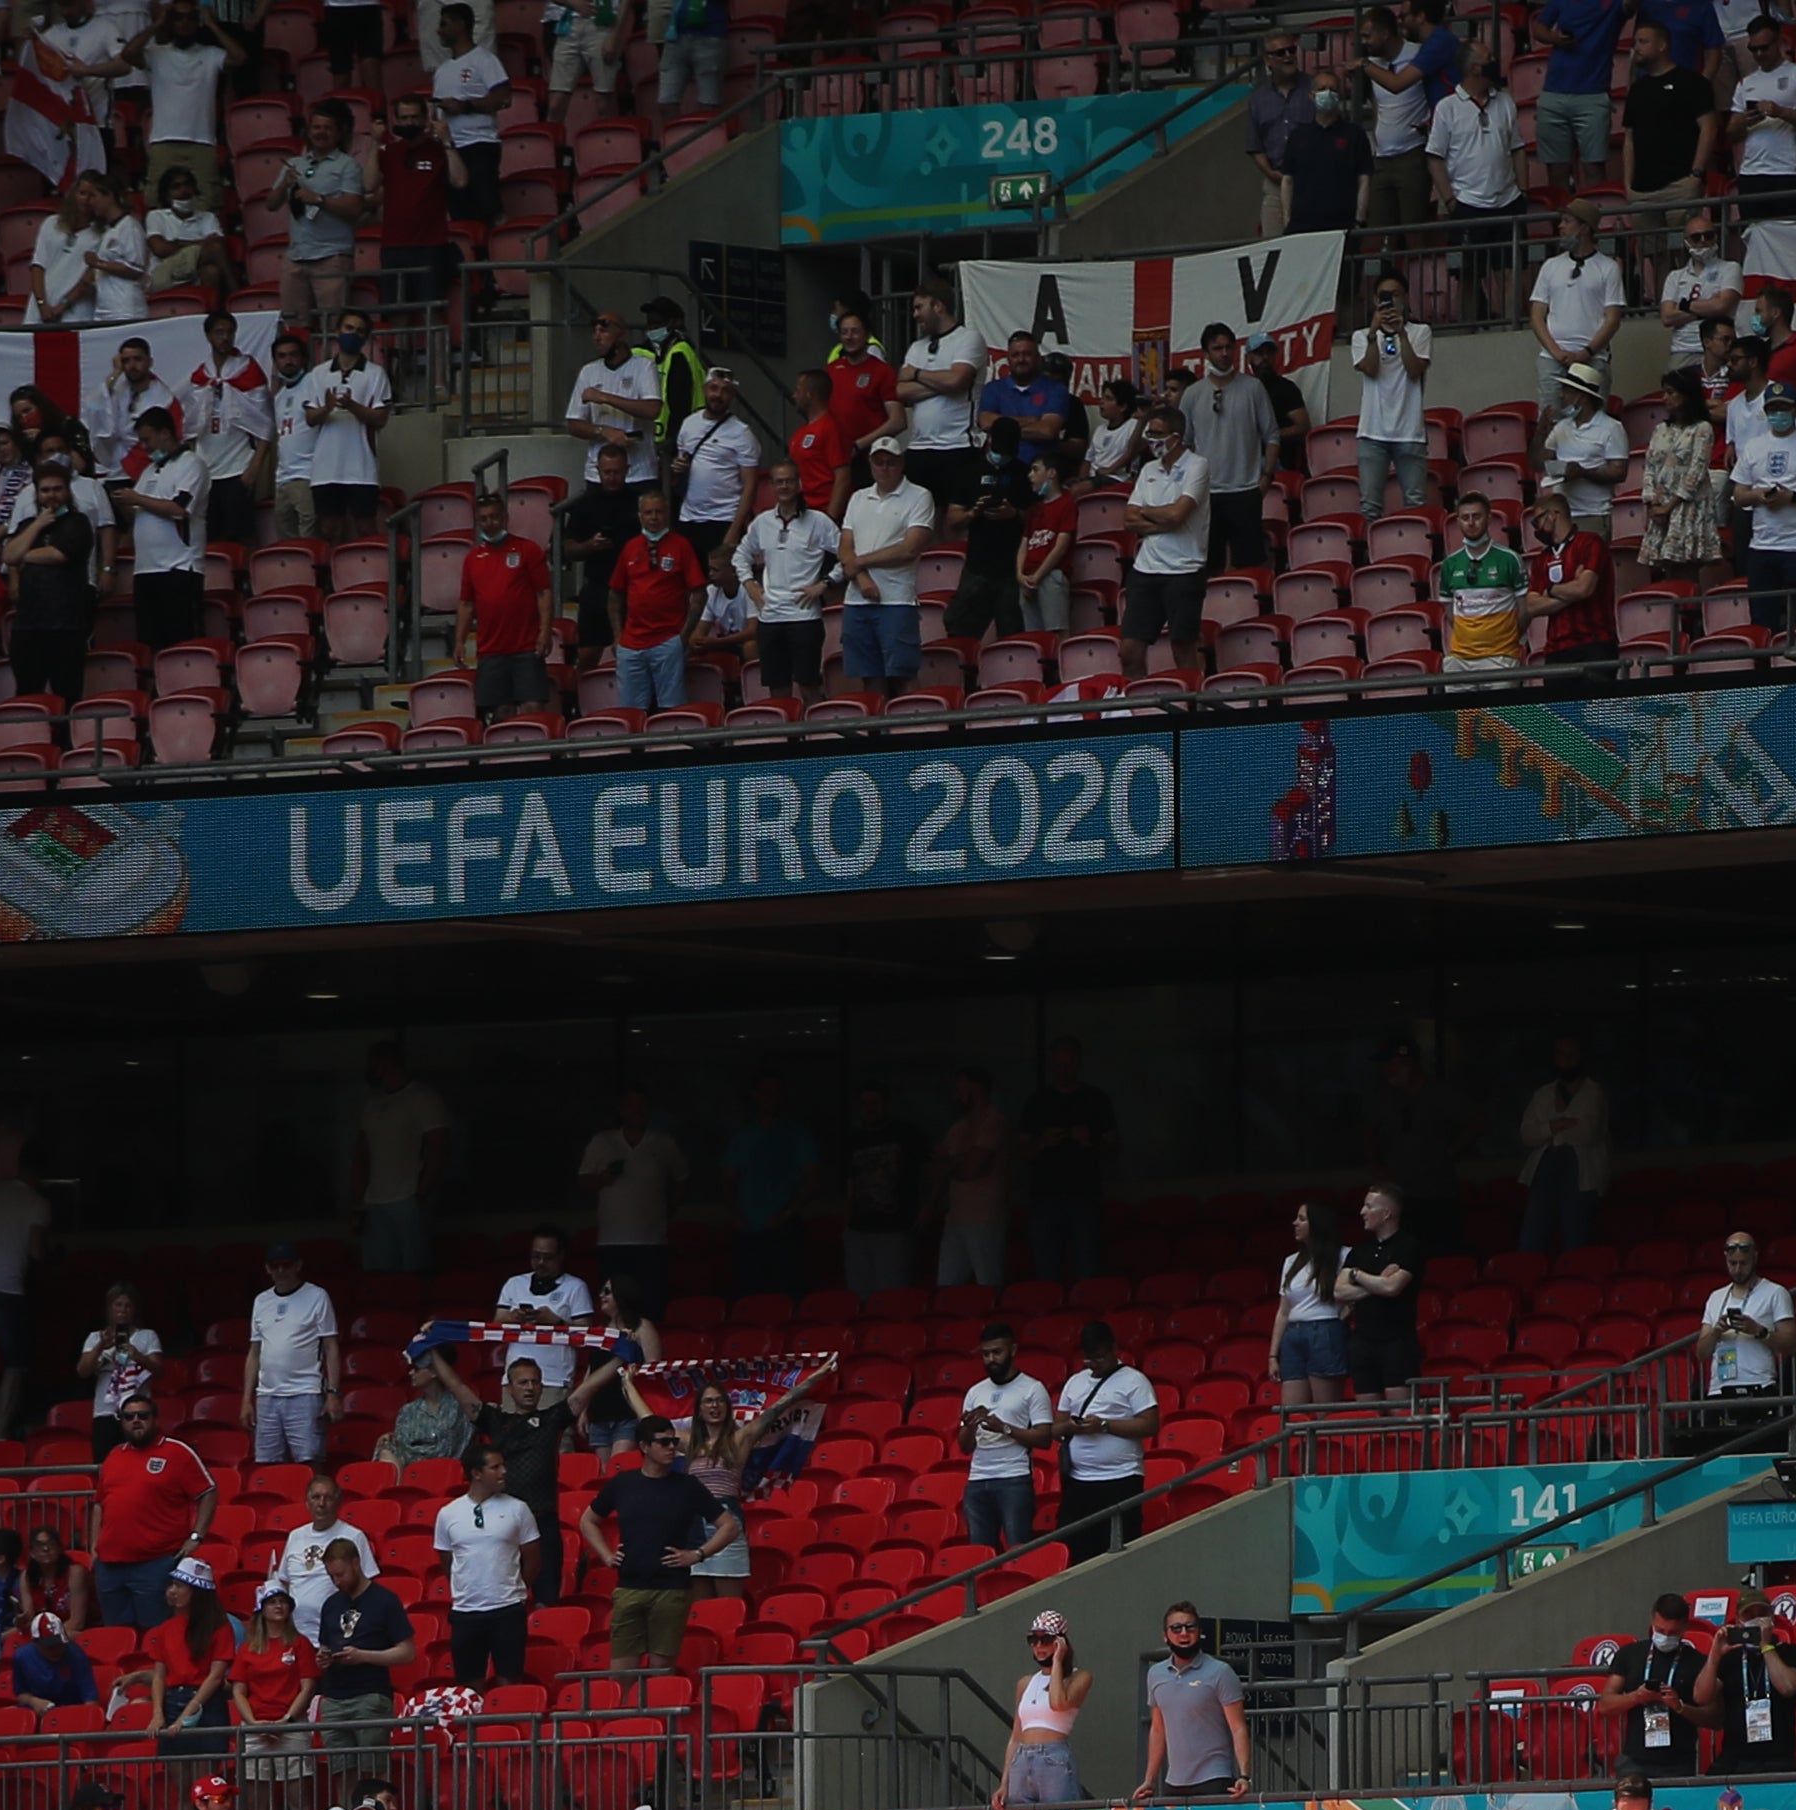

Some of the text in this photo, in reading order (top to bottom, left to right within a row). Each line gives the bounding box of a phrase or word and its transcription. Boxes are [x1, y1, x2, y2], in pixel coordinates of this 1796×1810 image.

[982, 117, 1058, 158] 248
[1236, 249, 1282, 324] V
[1030, 274, 1070, 345] A
[289, 744, 1176, 912] UEFA EURO 2020
[1510, 1483, 1582, 1527] 141
[1732, 1513, 1763, 1525] UEFA
[1764, 1511, 1796, 1523] EURO
[1225, 1632, 1251, 1643] ROWS
